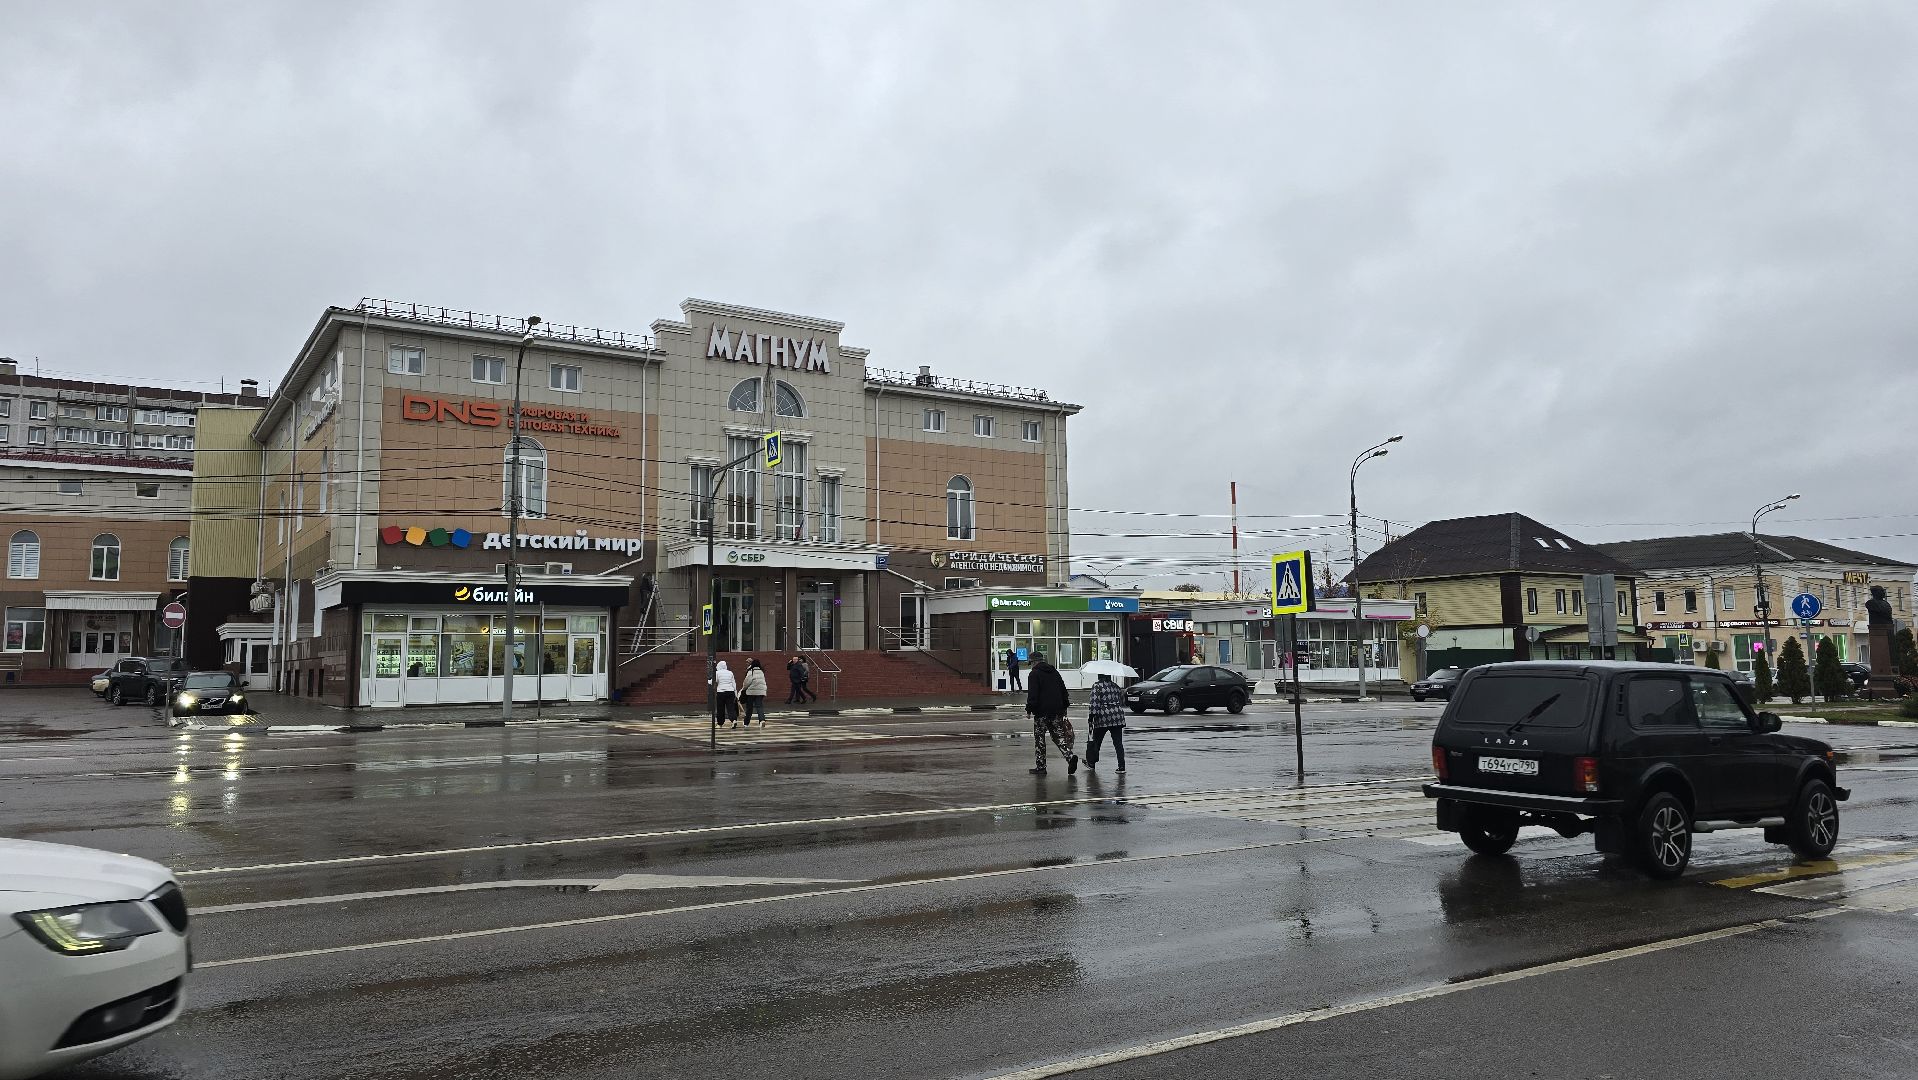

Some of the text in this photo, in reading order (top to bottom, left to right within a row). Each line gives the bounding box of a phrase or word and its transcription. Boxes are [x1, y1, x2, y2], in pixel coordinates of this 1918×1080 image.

[706, 321, 831, 373] МАГНУМ
[403, 395, 501, 427] DNS
[580, 412, 590, 423] И
[569, 422, 620, 437] ТЕХНИКА
[483, 529, 641, 556] детский мир
[740, 553, 765, 563] СБЕР
[1484, 738, 1529, 746] LADA
